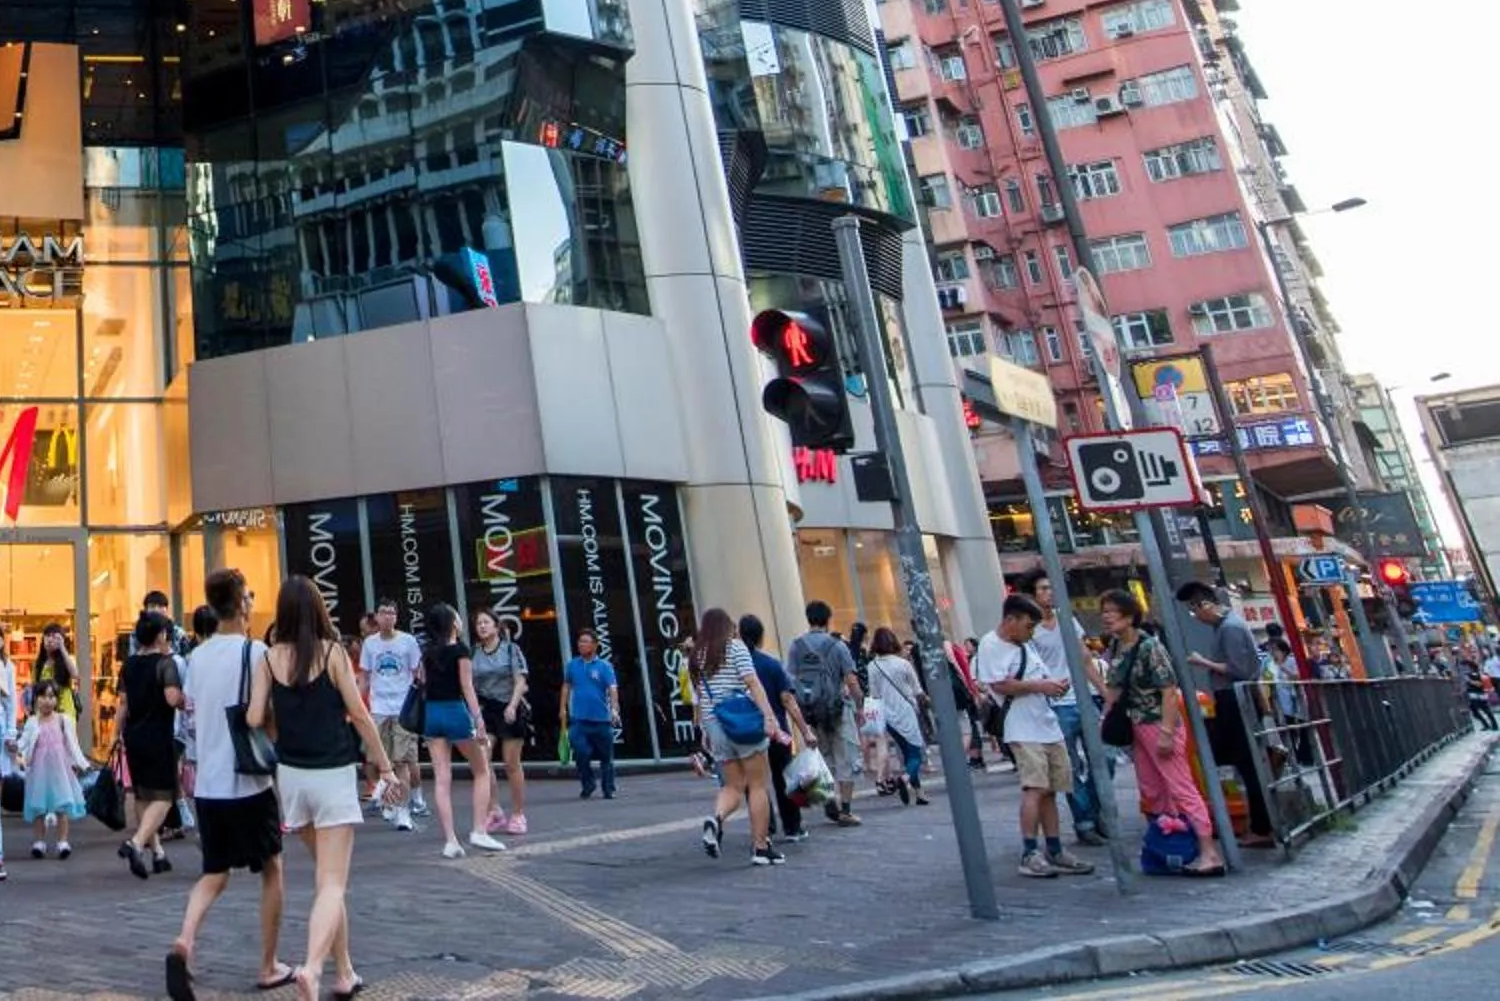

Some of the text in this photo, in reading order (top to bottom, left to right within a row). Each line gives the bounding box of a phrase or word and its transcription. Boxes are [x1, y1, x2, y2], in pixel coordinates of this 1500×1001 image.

[399, 503, 422, 583] HM.COM
[576, 488, 600, 573] HM.COM
[589, 576, 604, 595] IS
[1319, 560, 1337, 580] P
[407, 587, 423, 605] IS
[639, 494, 696, 743] MOVING SALE
